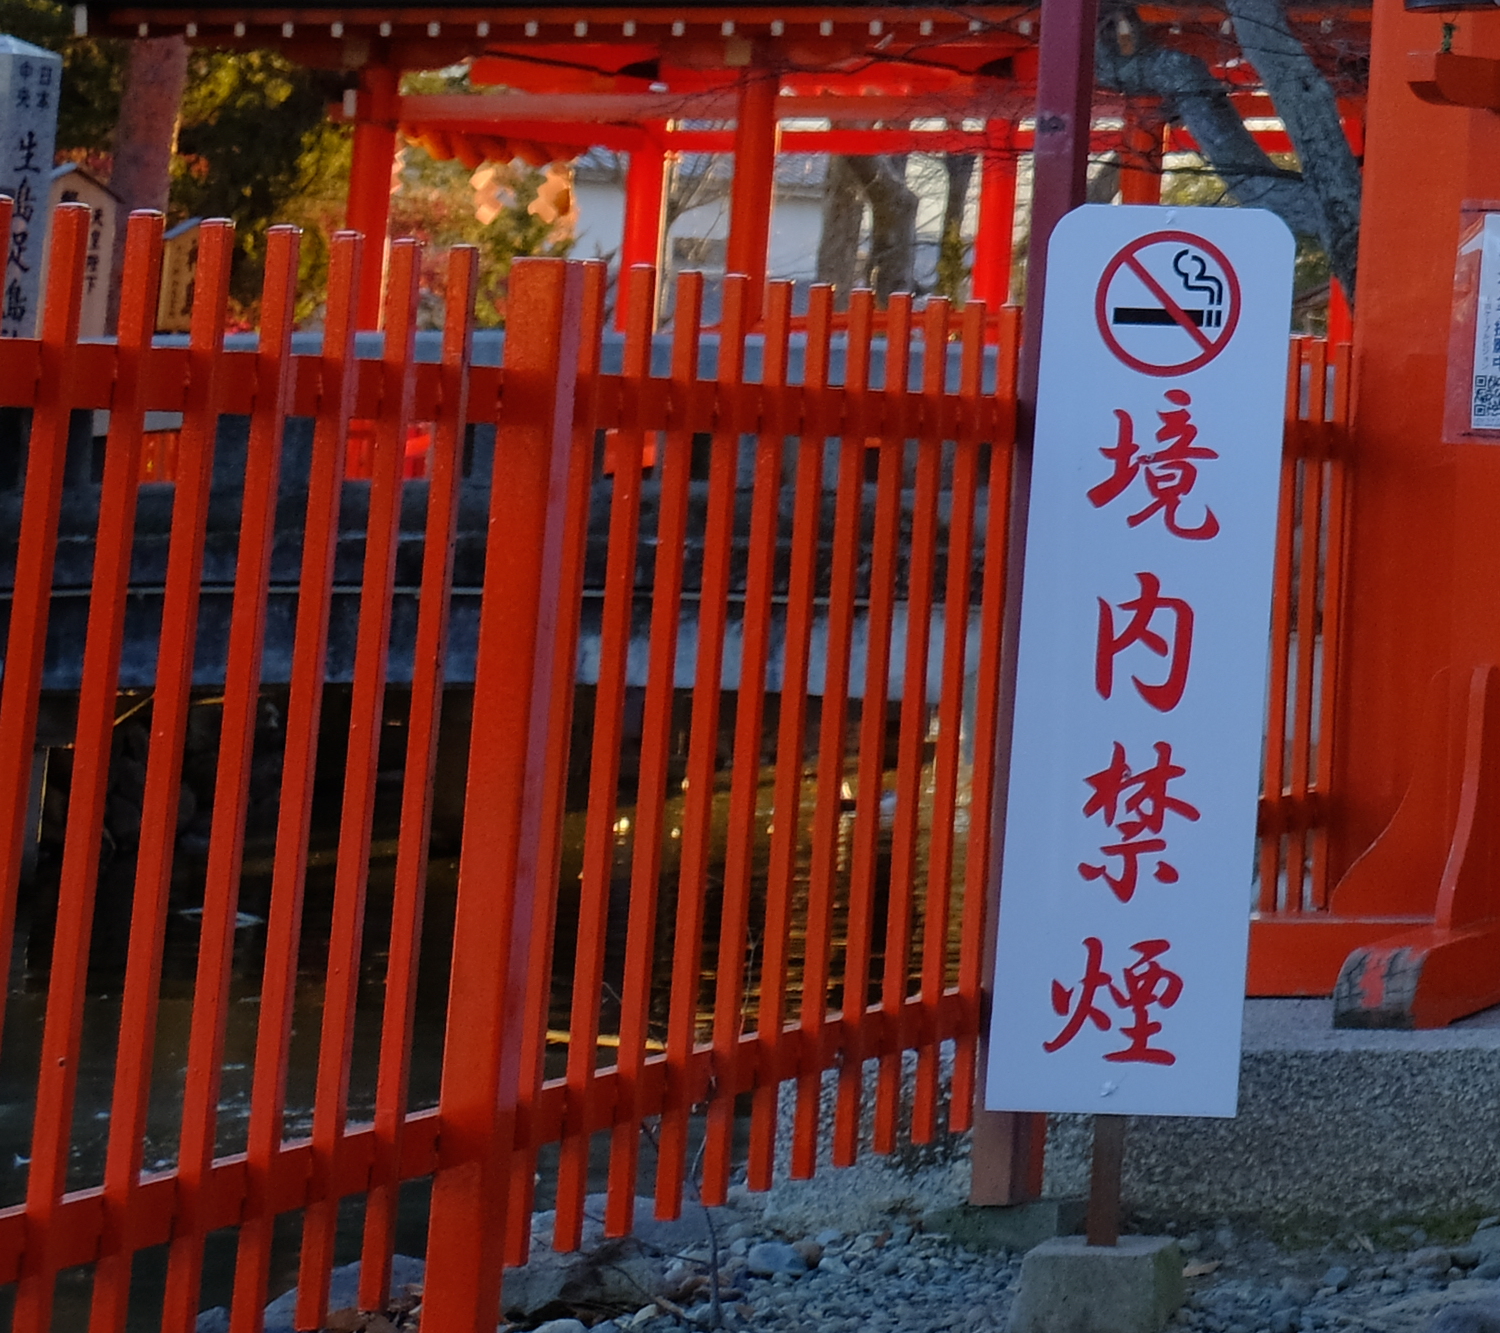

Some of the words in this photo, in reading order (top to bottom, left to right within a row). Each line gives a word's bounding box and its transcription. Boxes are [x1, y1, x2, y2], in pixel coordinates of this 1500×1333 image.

[35, 64, 53, 110] 日本
[1043, 388, 1220, 1068] 境内禁煙
